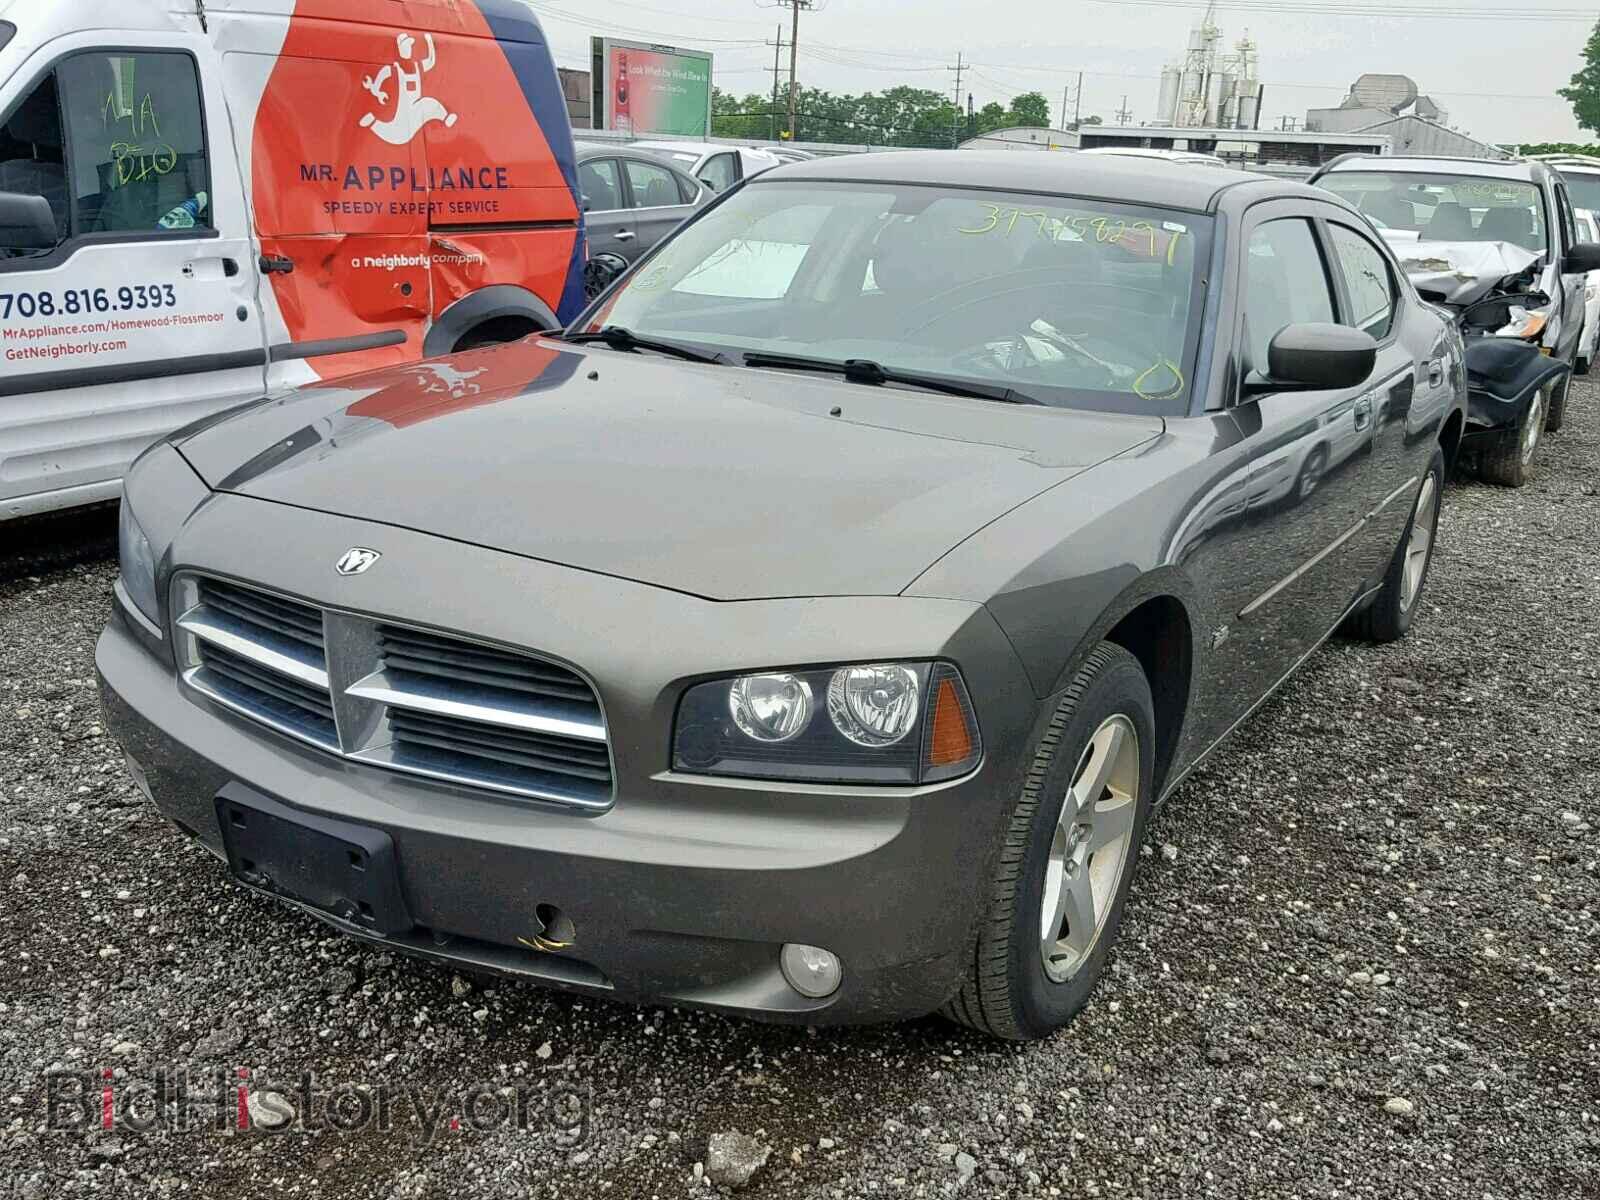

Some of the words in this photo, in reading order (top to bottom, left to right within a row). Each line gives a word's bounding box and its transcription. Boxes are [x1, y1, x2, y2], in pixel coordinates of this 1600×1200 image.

[301, 165, 337, 181] MR.
[343, 165, 510, 192] APPLIANCE
[323, 201, 382, 214] SPEEDY
[389, 201, 443, 215] EXPERT
[449, 200, 499, 214] SERVICE
[351, 256, 360, 268] a
[364, 253, 431, 270] neighborly
[0, 284, 176, 319] 708.816.9393
[3, 312, 224, 340] MrAppliance.com/Homewood-Flossmoor
[6, 338, 127, 361] GetNeighborly.com
